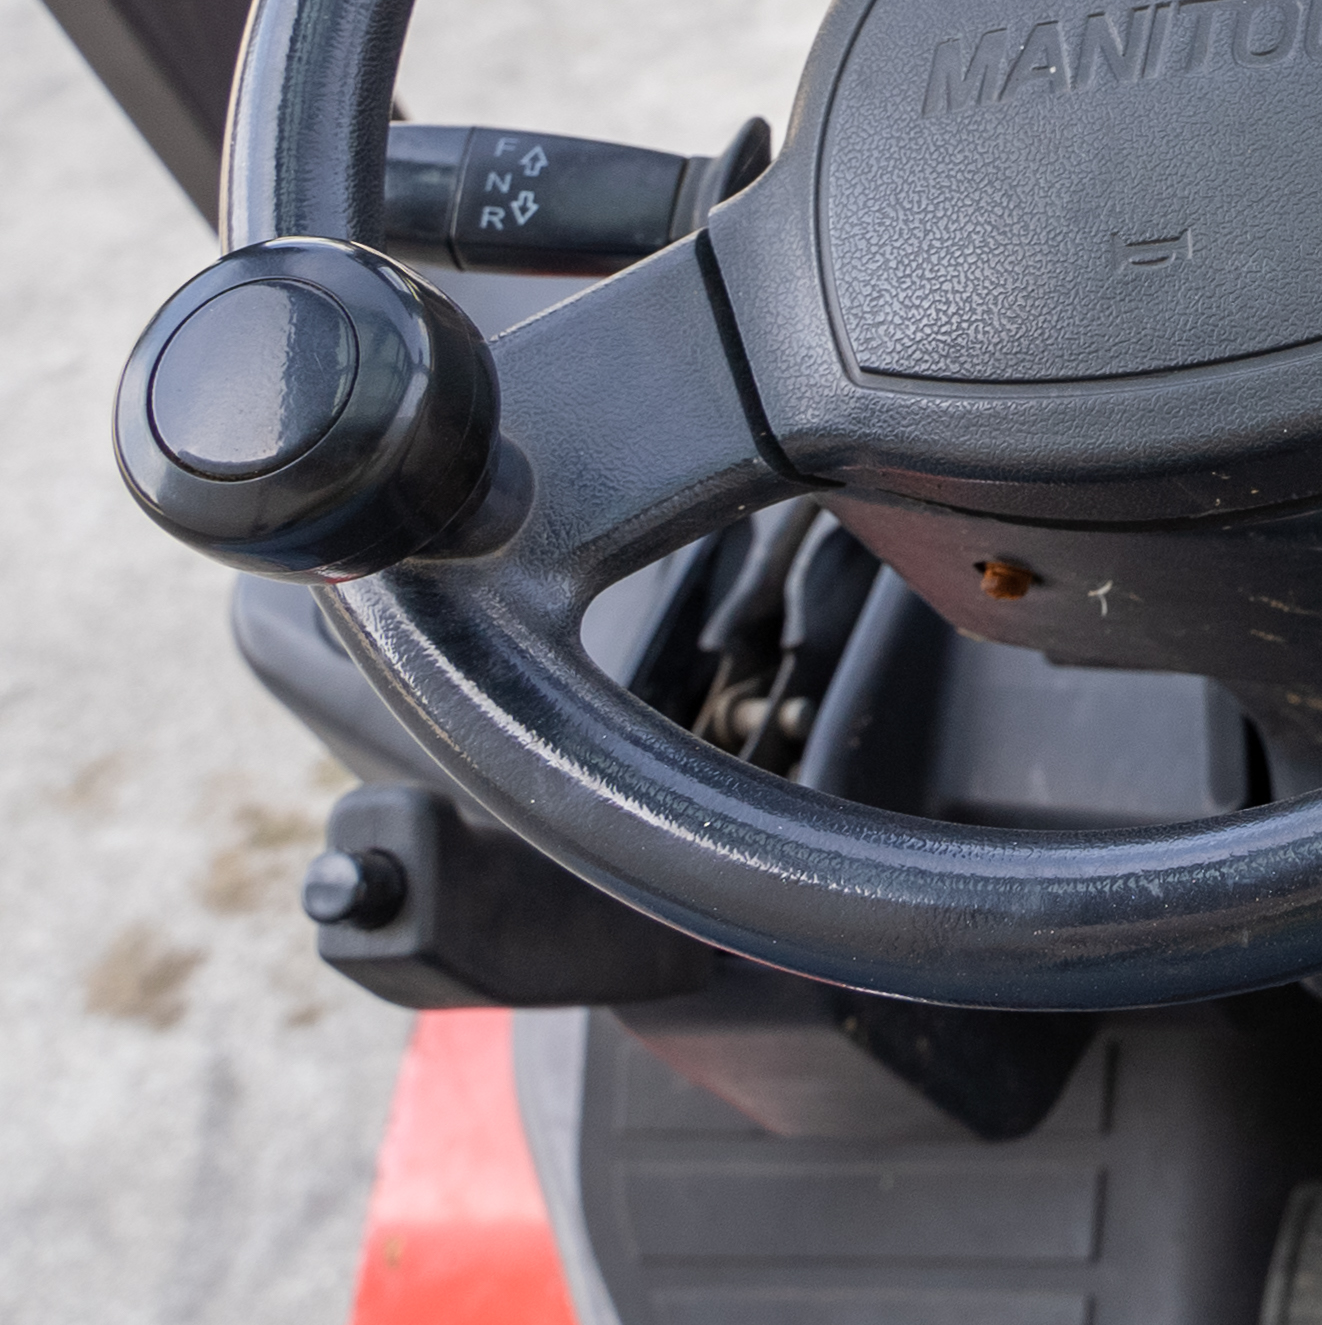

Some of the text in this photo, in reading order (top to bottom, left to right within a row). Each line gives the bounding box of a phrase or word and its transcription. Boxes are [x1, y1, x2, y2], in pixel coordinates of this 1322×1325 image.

[494, 137, 519, 157] F
[484, 171, 513, 194] N
[480, 206, 506, 231] R
